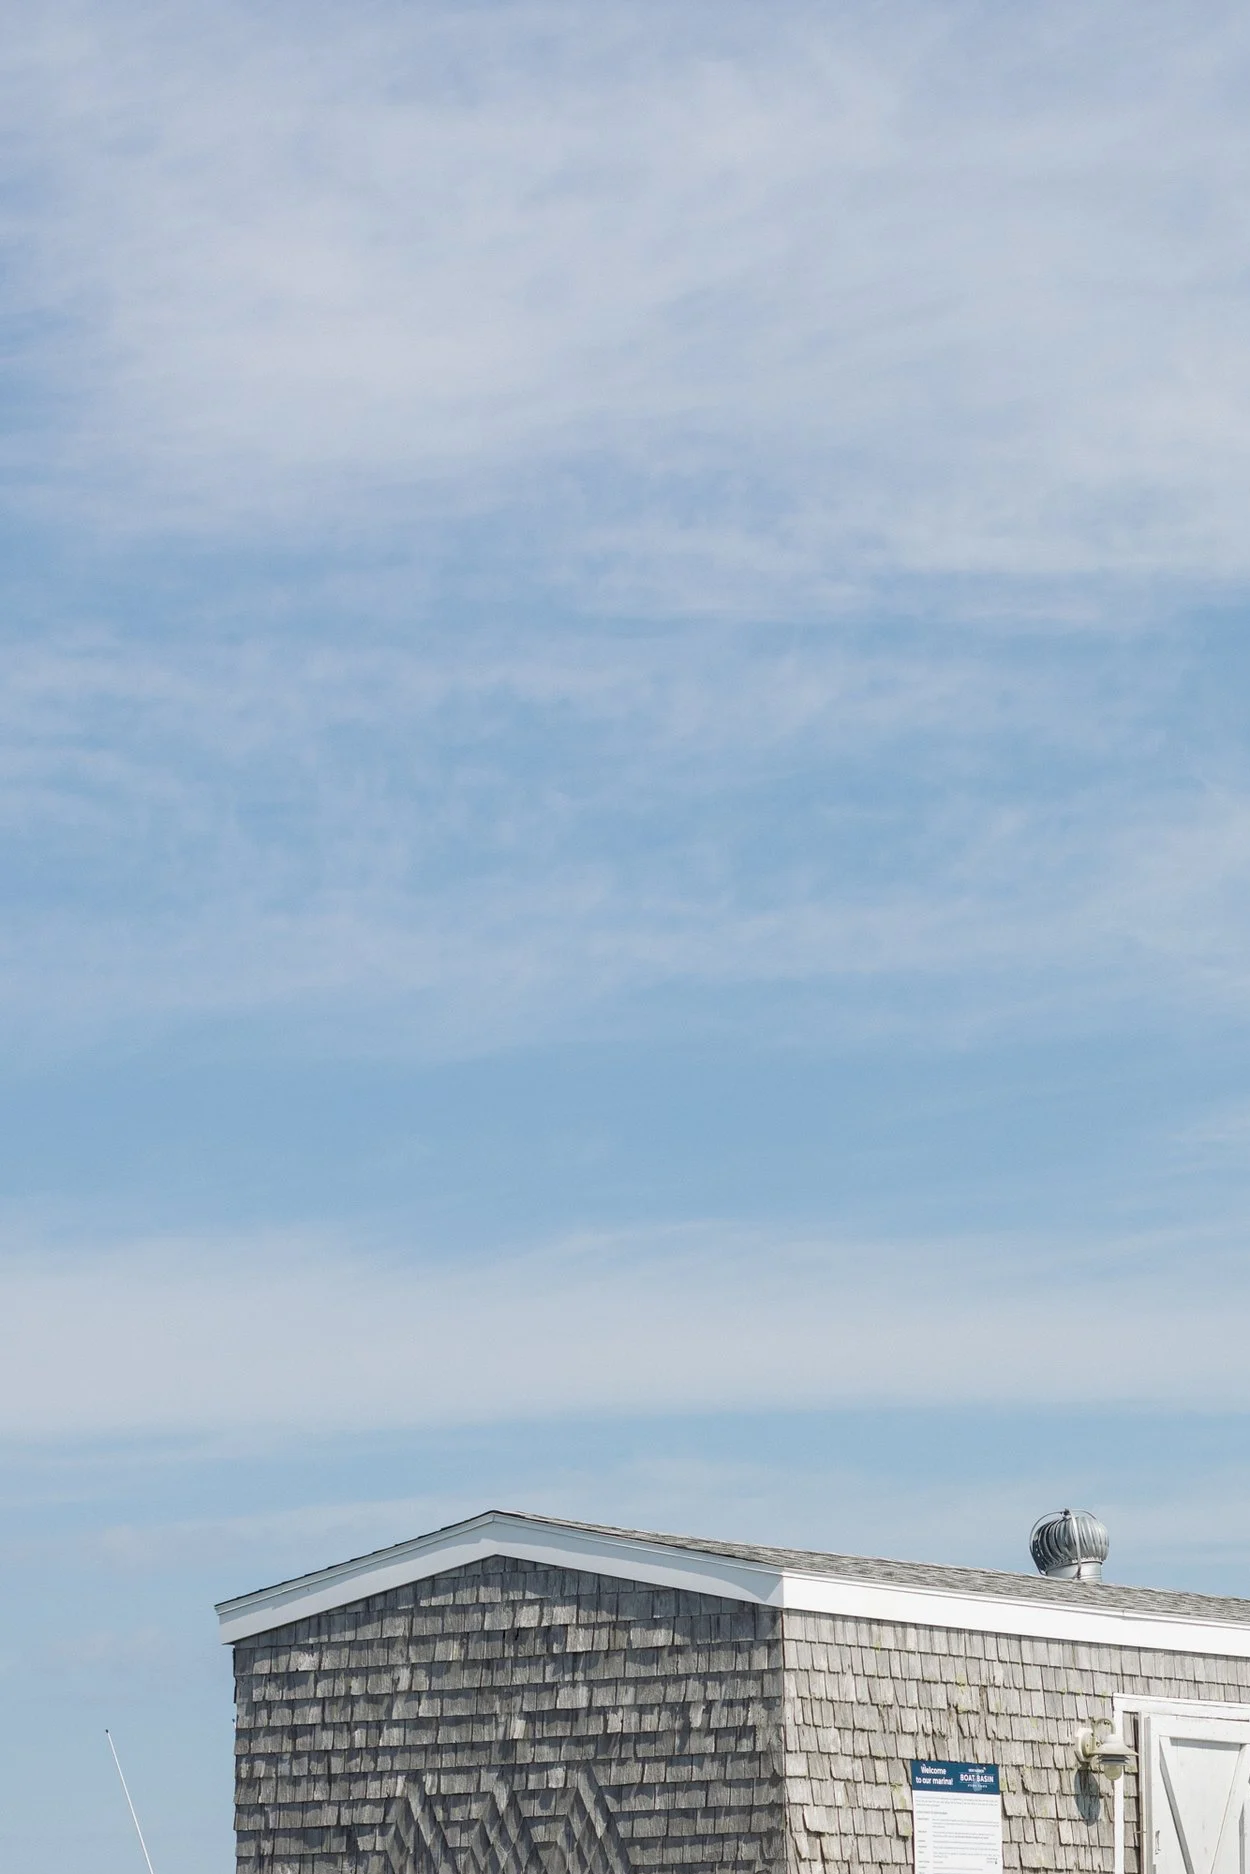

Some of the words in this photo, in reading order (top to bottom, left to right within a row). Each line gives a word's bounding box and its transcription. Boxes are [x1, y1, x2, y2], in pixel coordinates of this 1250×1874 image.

[921, 1765, 947, 1775] Welcome
[960, 1773, 975, 1782] BOAT
[976, 1774, 994, 1783] BASIN
